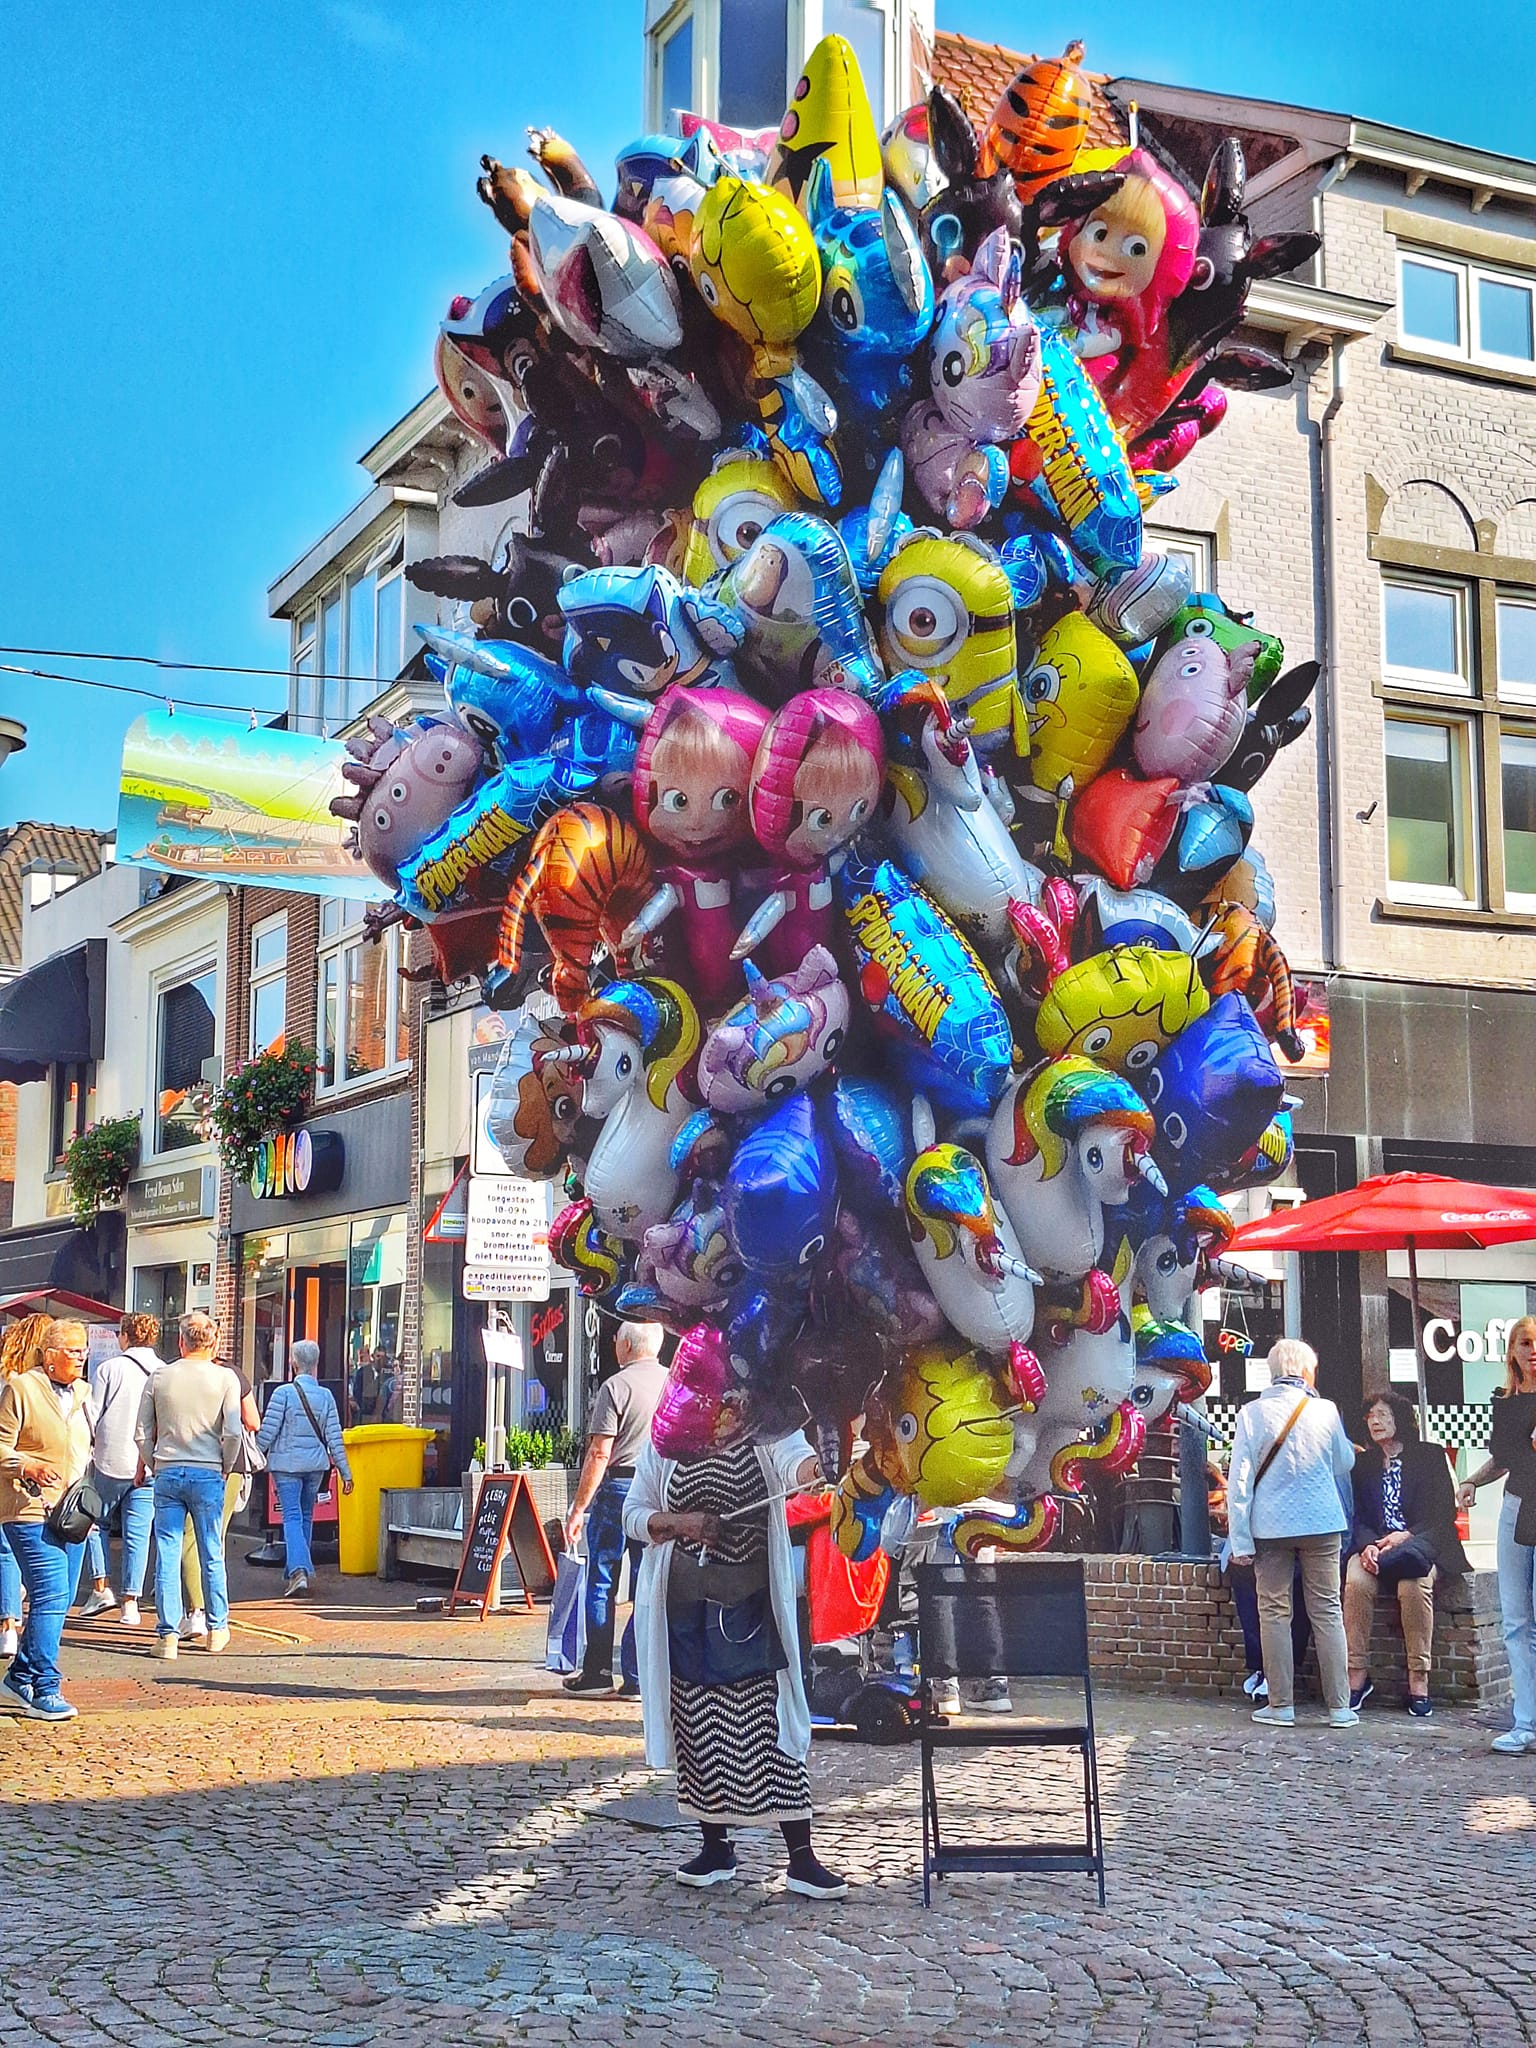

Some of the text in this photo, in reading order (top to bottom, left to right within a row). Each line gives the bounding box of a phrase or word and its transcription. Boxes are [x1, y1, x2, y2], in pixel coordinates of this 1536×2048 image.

[1027, 379, 1099, 530] IDER-MAN
[416, 807, 531, 912] SPIDER-MAN
[845, 895, 949, 1041] SPIDER-MAN
[896, 930, 955, 1005] AMAZING
[497, 1183, 527, 1192] fietsen
[487, 1194, 535, 1204] toegestaan
[471, 1216, 517, 1226] koopavond
[533, 1218, 542, 1226] 21
[1440, 1210, 1532, 1223] Coca-Cola
[483, 1241, 536, 1250] bromfietsen
[475, 1252, 543, 1263] niet toegestaan
[468, 1271, 546, 1281] expeditieverkeer
[481, 1283, 533, 1293] toegestaan
[1218, 1331, 1253, 1357] open
[545, 1350, 563, 1363] Corner
